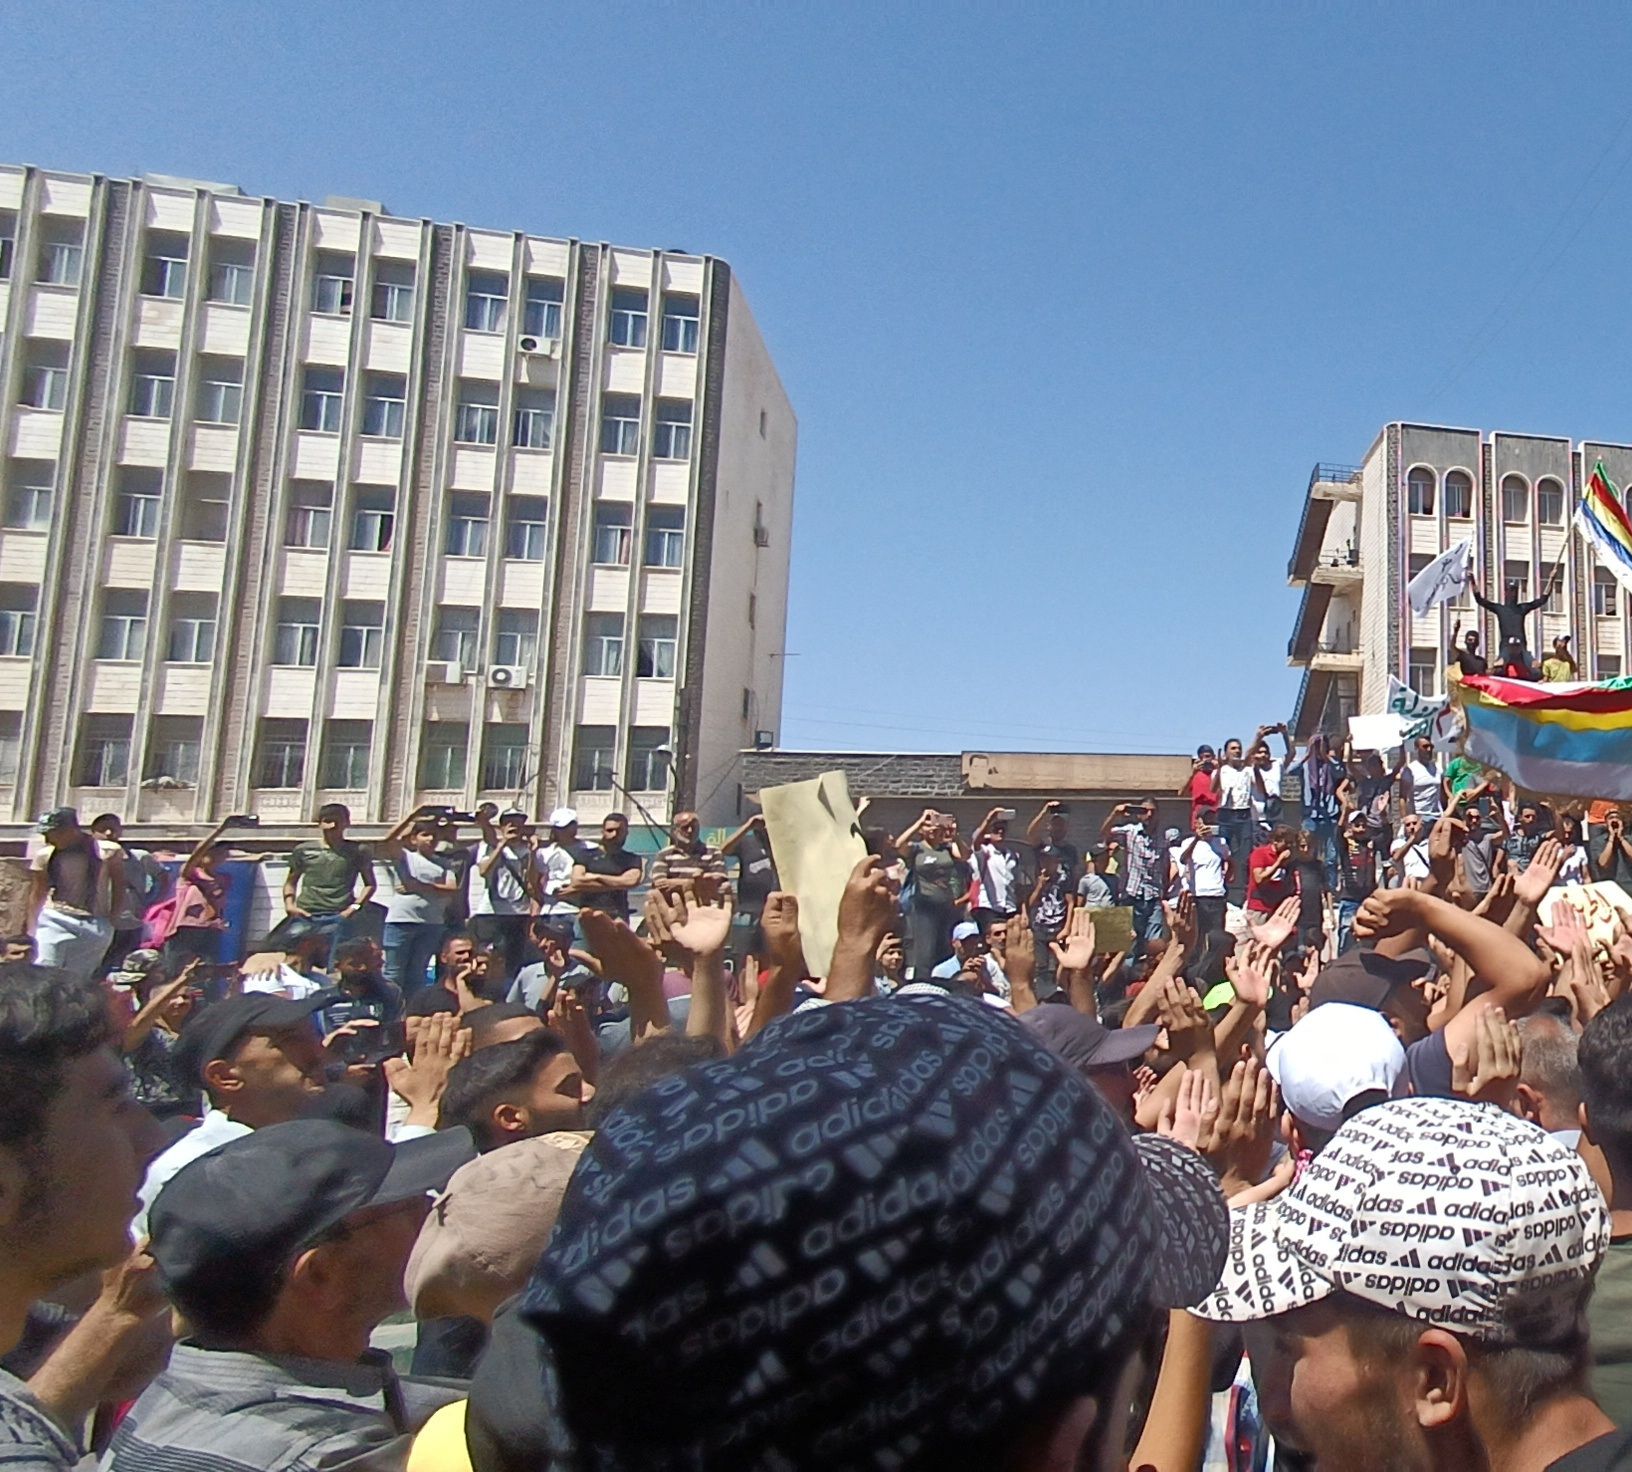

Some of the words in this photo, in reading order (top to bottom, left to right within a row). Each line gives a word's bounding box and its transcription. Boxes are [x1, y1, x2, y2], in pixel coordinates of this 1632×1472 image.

[1397, 1170, 1474, 1192] adidas
[1306, 1192, 1355, 1223] adidas
[1379, 1220, 1455, 1243] adidas
[1524, 1215, 1576, 1240] adidas
[1364, 1274, 1440, 1297] adidas
